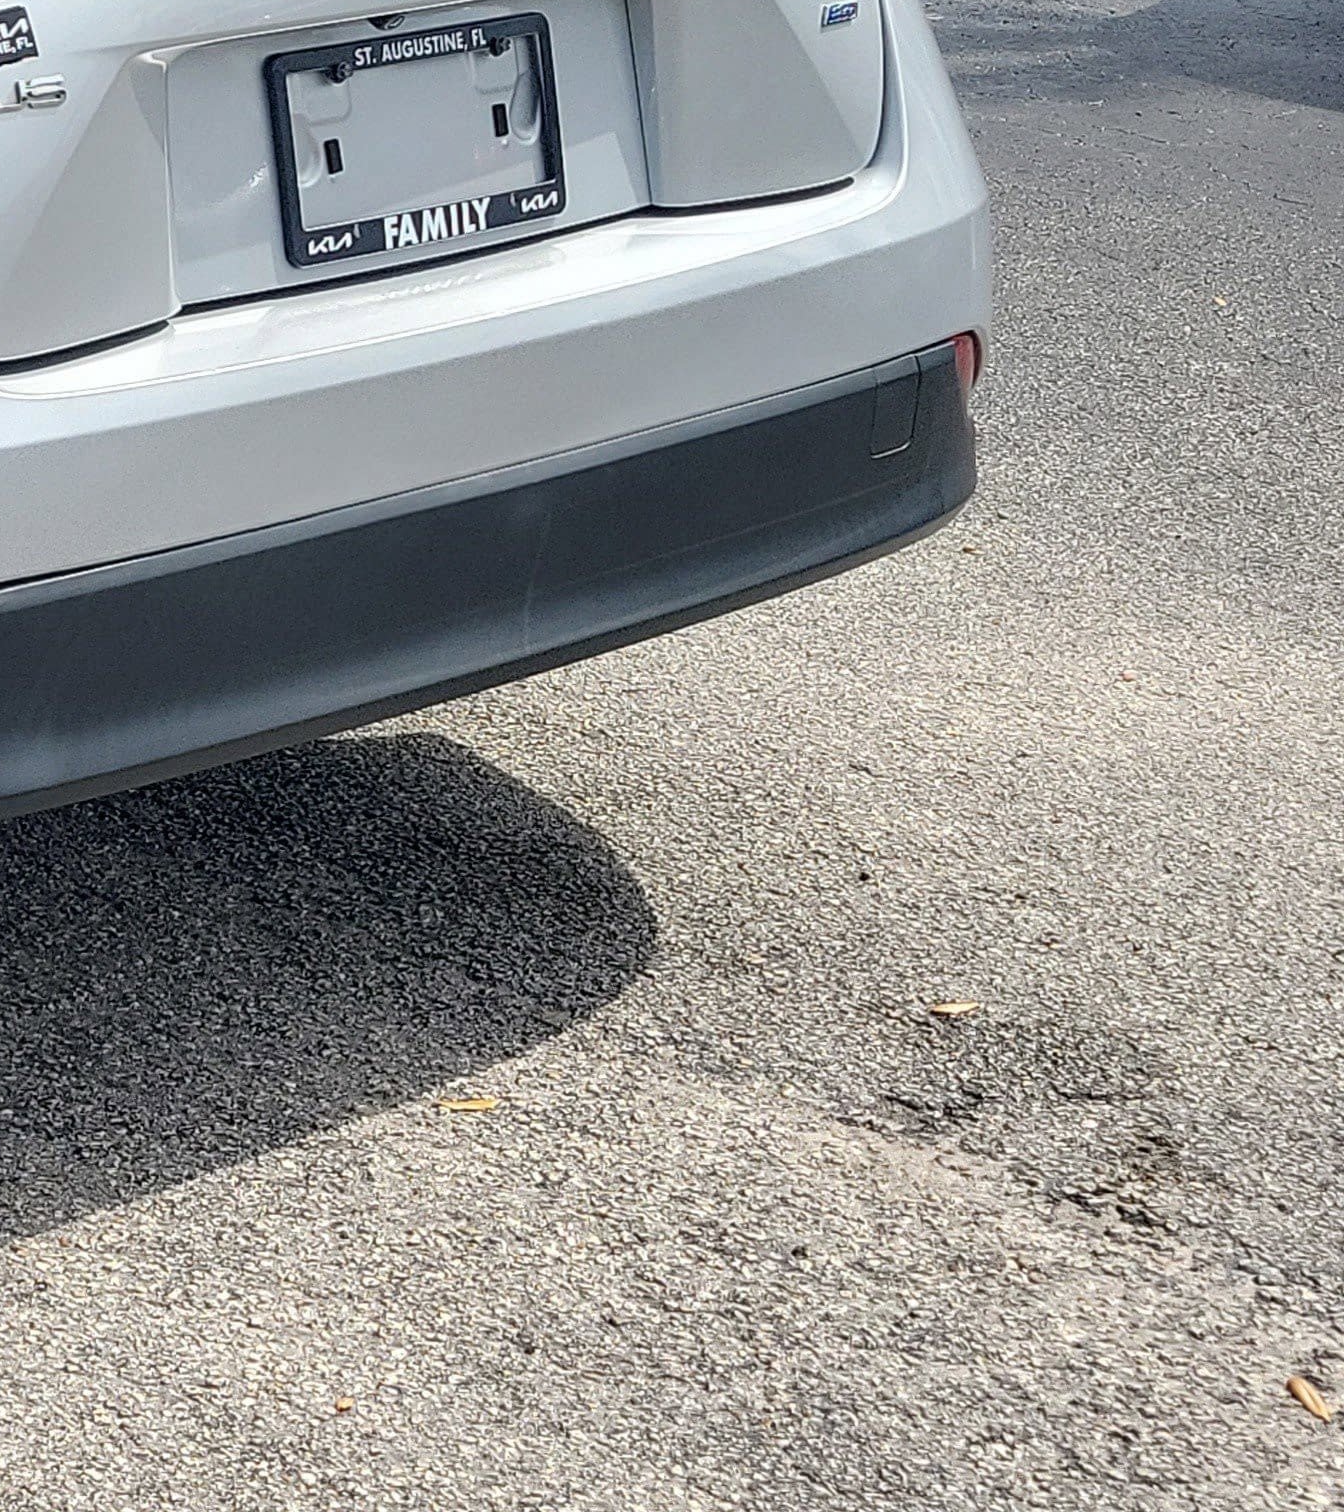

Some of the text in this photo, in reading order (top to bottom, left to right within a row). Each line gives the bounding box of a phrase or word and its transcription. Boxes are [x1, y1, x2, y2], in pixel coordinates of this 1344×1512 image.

[16, 36, 34, 51] FL
[354, 28, 487, 67] ST. AUGUSTINE, FL
[308, 190, 558, 256] KIA FAMILY KIA
